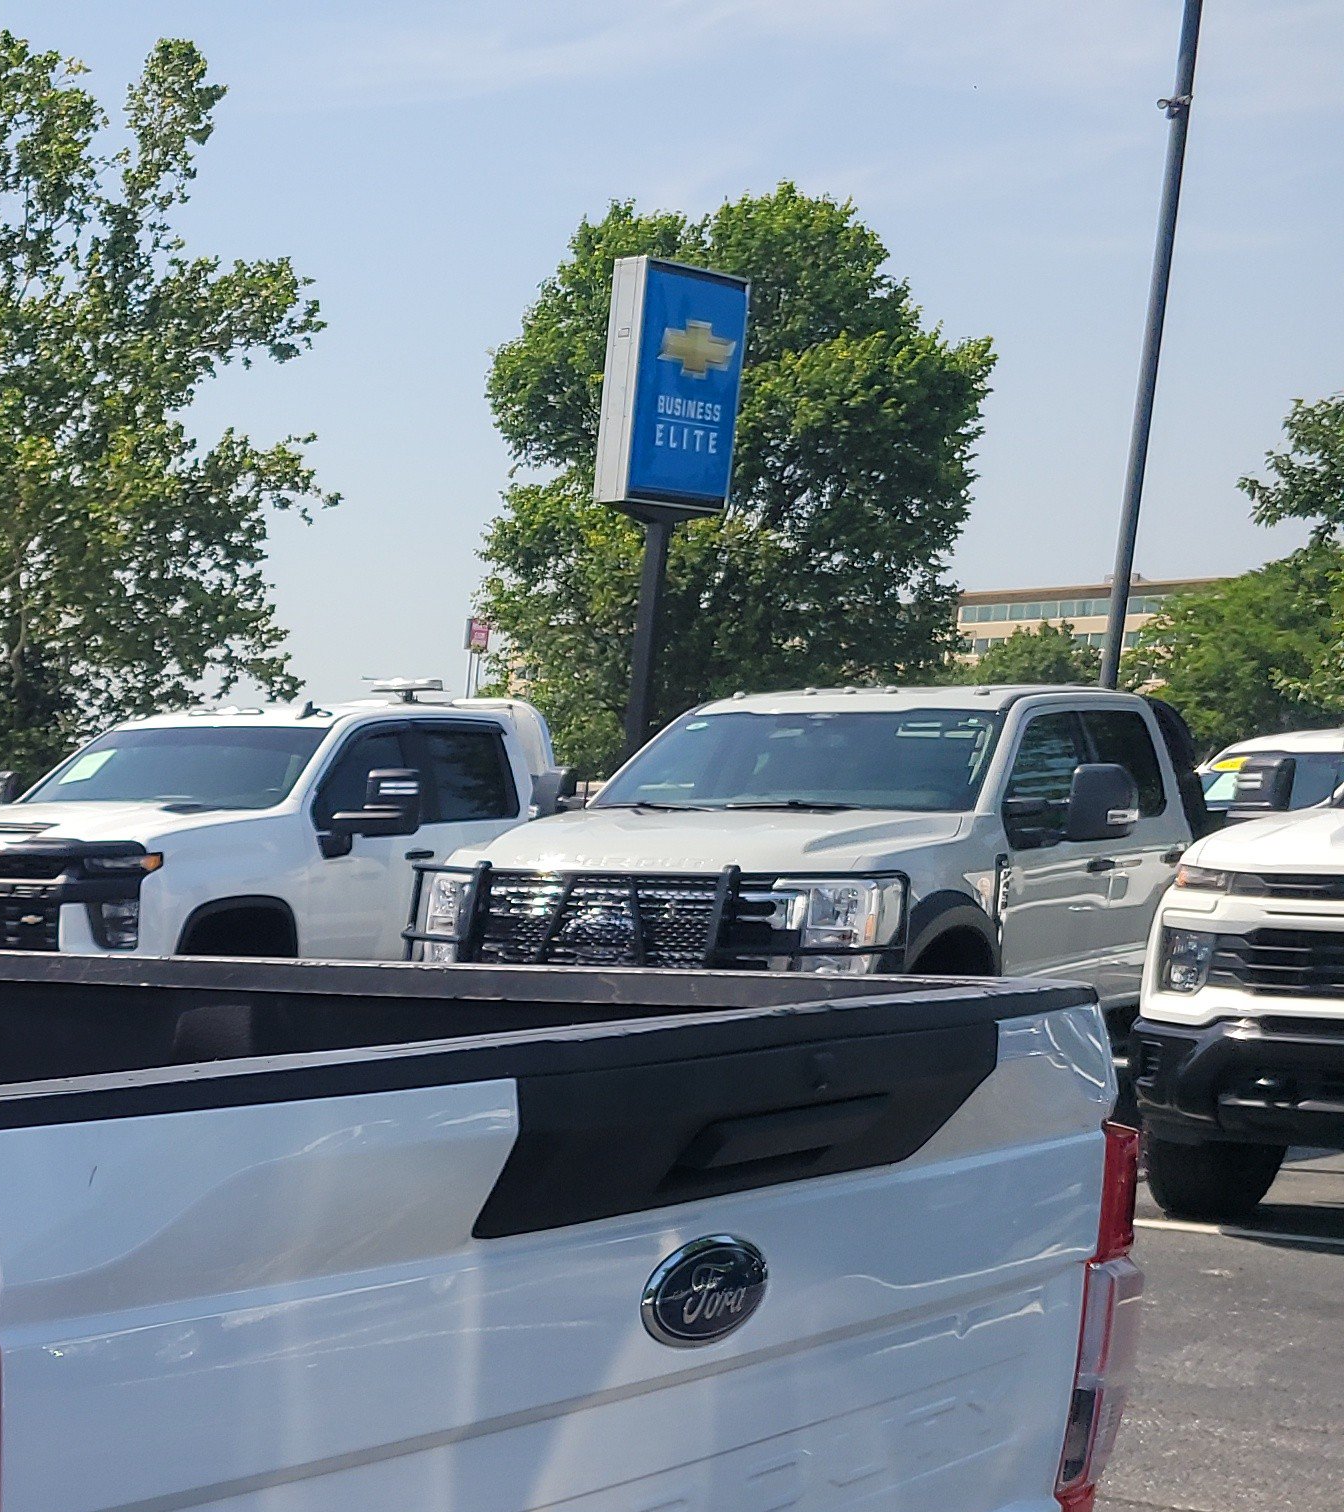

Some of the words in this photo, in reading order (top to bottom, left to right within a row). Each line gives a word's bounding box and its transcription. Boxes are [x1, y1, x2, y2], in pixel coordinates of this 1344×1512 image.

[656, 394, 722, 424] BUSINESS
[654, 423, 719, 455] ELITE
[682, 1261, 747, 1325] Ford
